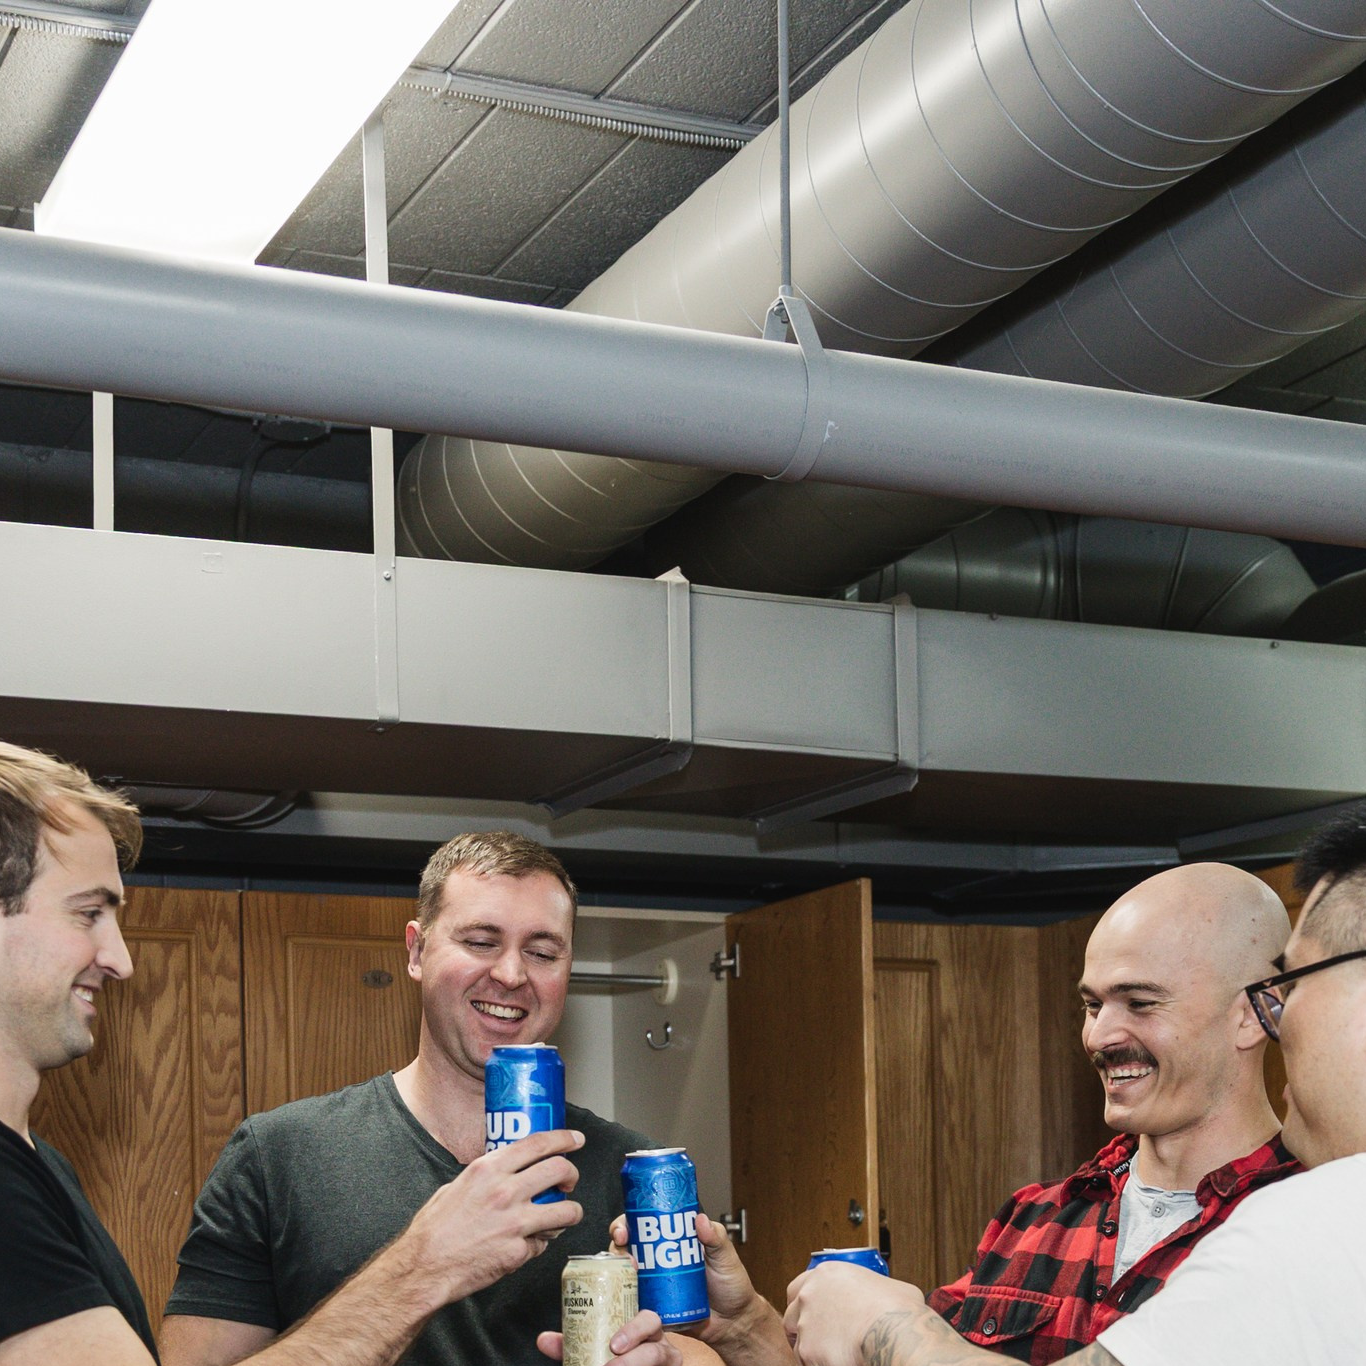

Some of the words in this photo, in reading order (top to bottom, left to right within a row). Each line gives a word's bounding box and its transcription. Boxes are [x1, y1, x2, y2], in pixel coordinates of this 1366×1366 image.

[486, 1111, 531, 1141] UD
[637, 1210, 698, 1243] BUD
[631, 1238, 705, 1270] LIGH
